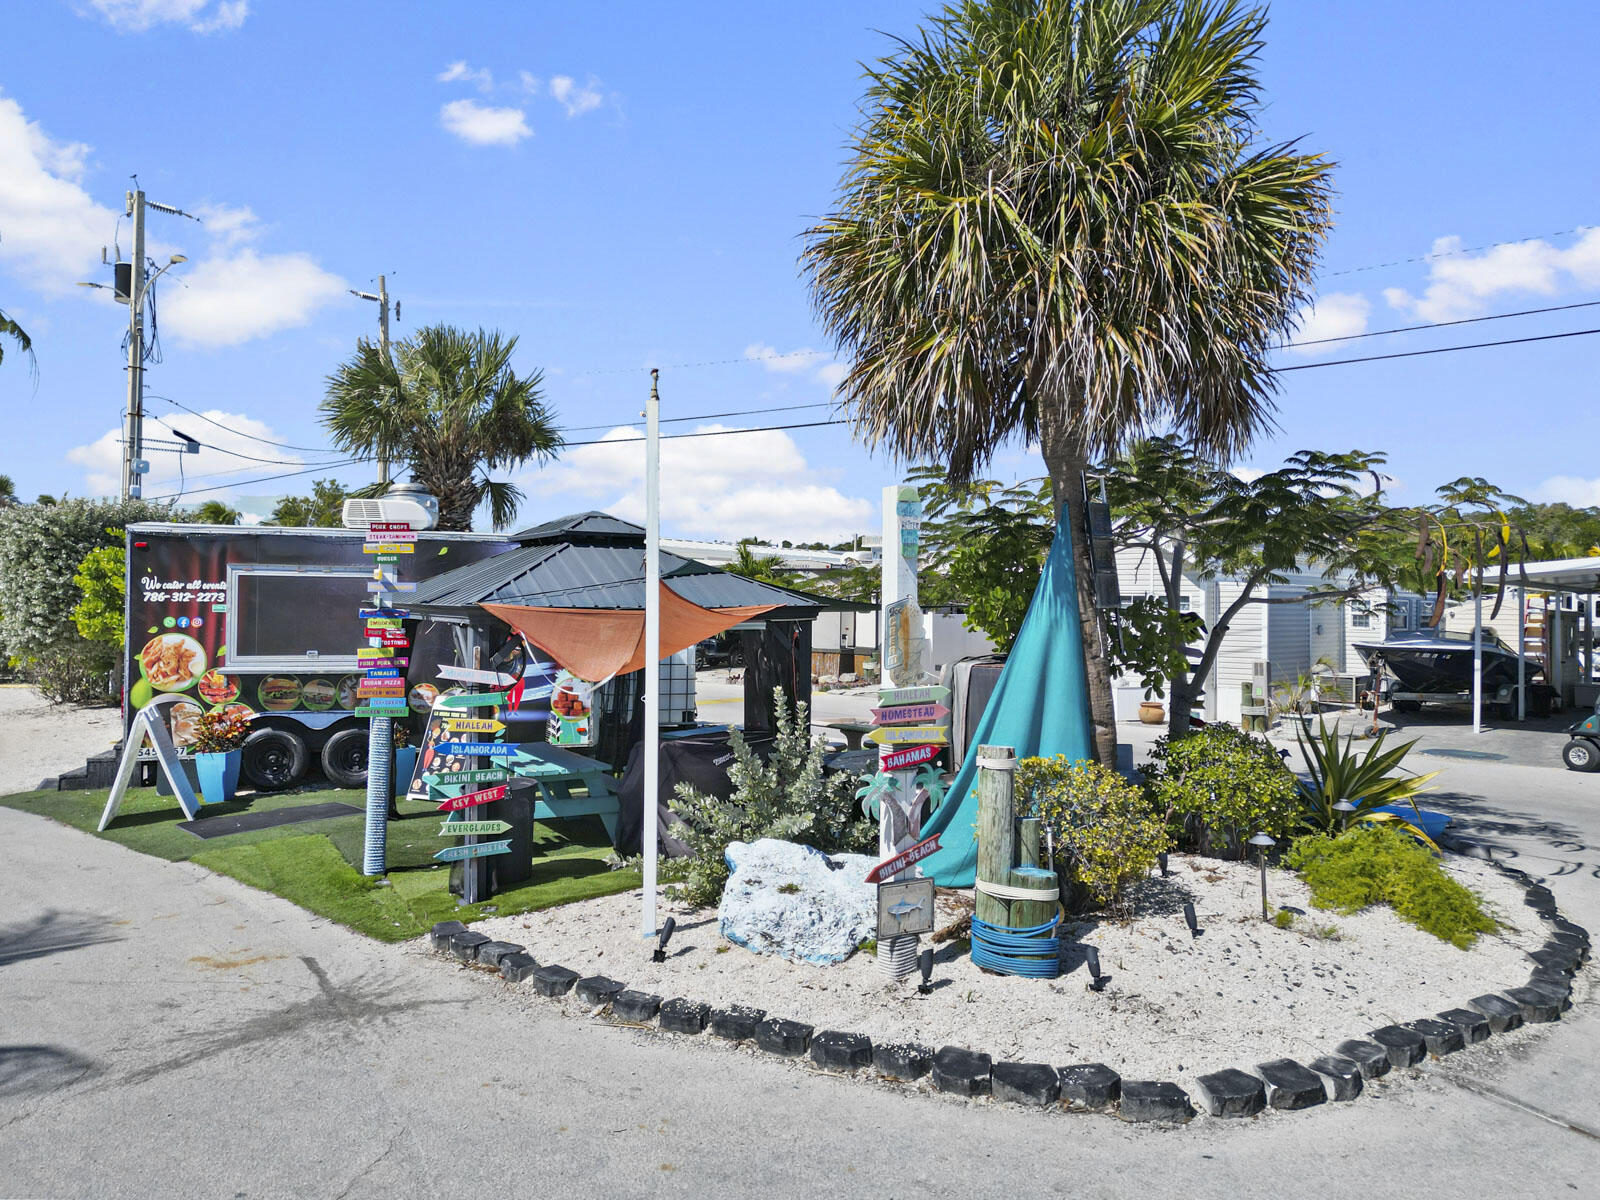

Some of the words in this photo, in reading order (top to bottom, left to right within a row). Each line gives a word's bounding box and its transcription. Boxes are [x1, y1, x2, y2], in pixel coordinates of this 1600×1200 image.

[141, 576, 161, 590] We
[162, 580, 185, 590] cater
[186, 579, 202, 590] all
[143, 591, 225, 602] 786-312-2273
[894, 688, 931, 701] HIALEAH
[881, 707, 935, 721] HOMESTEAD
[455, 721, 493, 730] HIALEAH
[451, 744, 508, 754] ISLAMORADA
[887, 747, 931, 768] BAHAMAS
[444, 773, 471, 784] BIKINI
[475, 771, 503, 781] BEACH
[452, 797, 470, 809] KEY
[474, 789, 498, 802] WEST
[447, 823, 501, 833] EVERGLADES
[879, 856, 906, 880] BIKINI
[908, 840, 937, 862] BEACH
